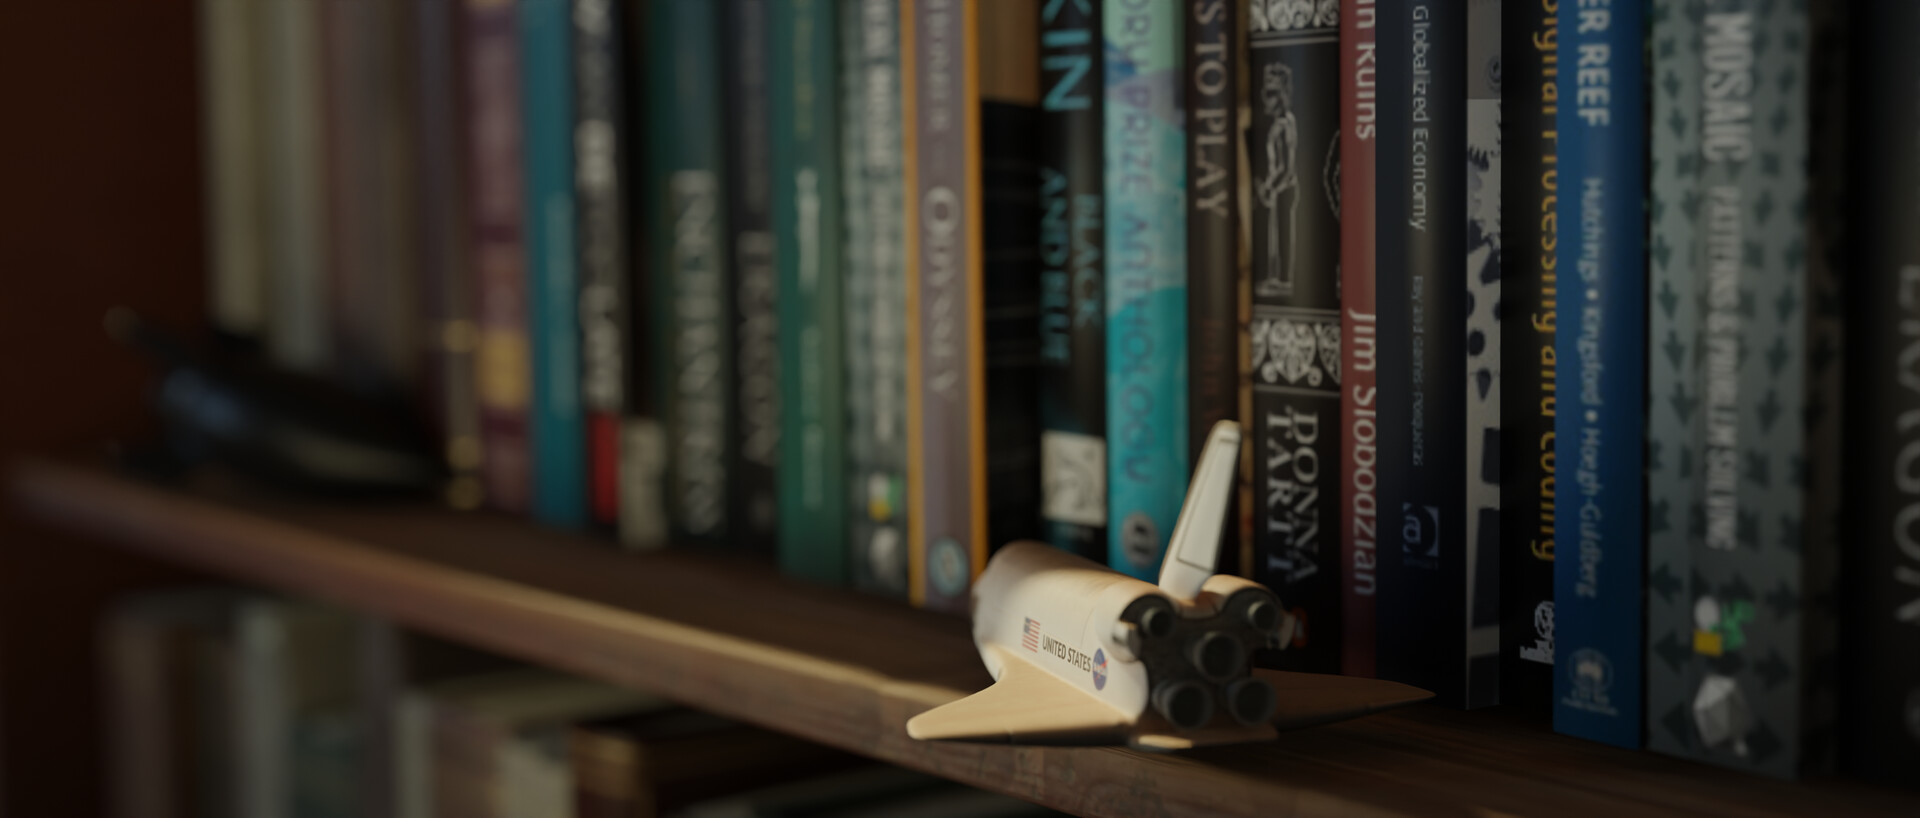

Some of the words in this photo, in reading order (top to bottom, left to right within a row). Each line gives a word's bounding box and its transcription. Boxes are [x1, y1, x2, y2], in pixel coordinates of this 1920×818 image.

[1195, 32, 1228, 97] TO
[1355, 42, 1377, 141] Ruins
[1412, 5, 1431, 123] Globalized
[1577, 43, 1612, 127] REEF
[1703, 12, 1753, 162] MOSAIC
[1195, 107, 1228, 219] PLAY
[1409, 127, 1429, 232] Economy
[1039, 166, 1069, 267] AND
[1073, 193, 1103, 328] BLACK
[1577, 177, 1604, 281] Hutchings
[1348, 308, 1377, 372] Jim
[1266, 405, 1294, 572] TARTT
[1285, 411, 1320, 584] DONNA
[1352, 384, 1377, 597] Slobodzian
[1042, 634, 1067, 660] UNITED
[1067, 648, 1092, 673] STATES
